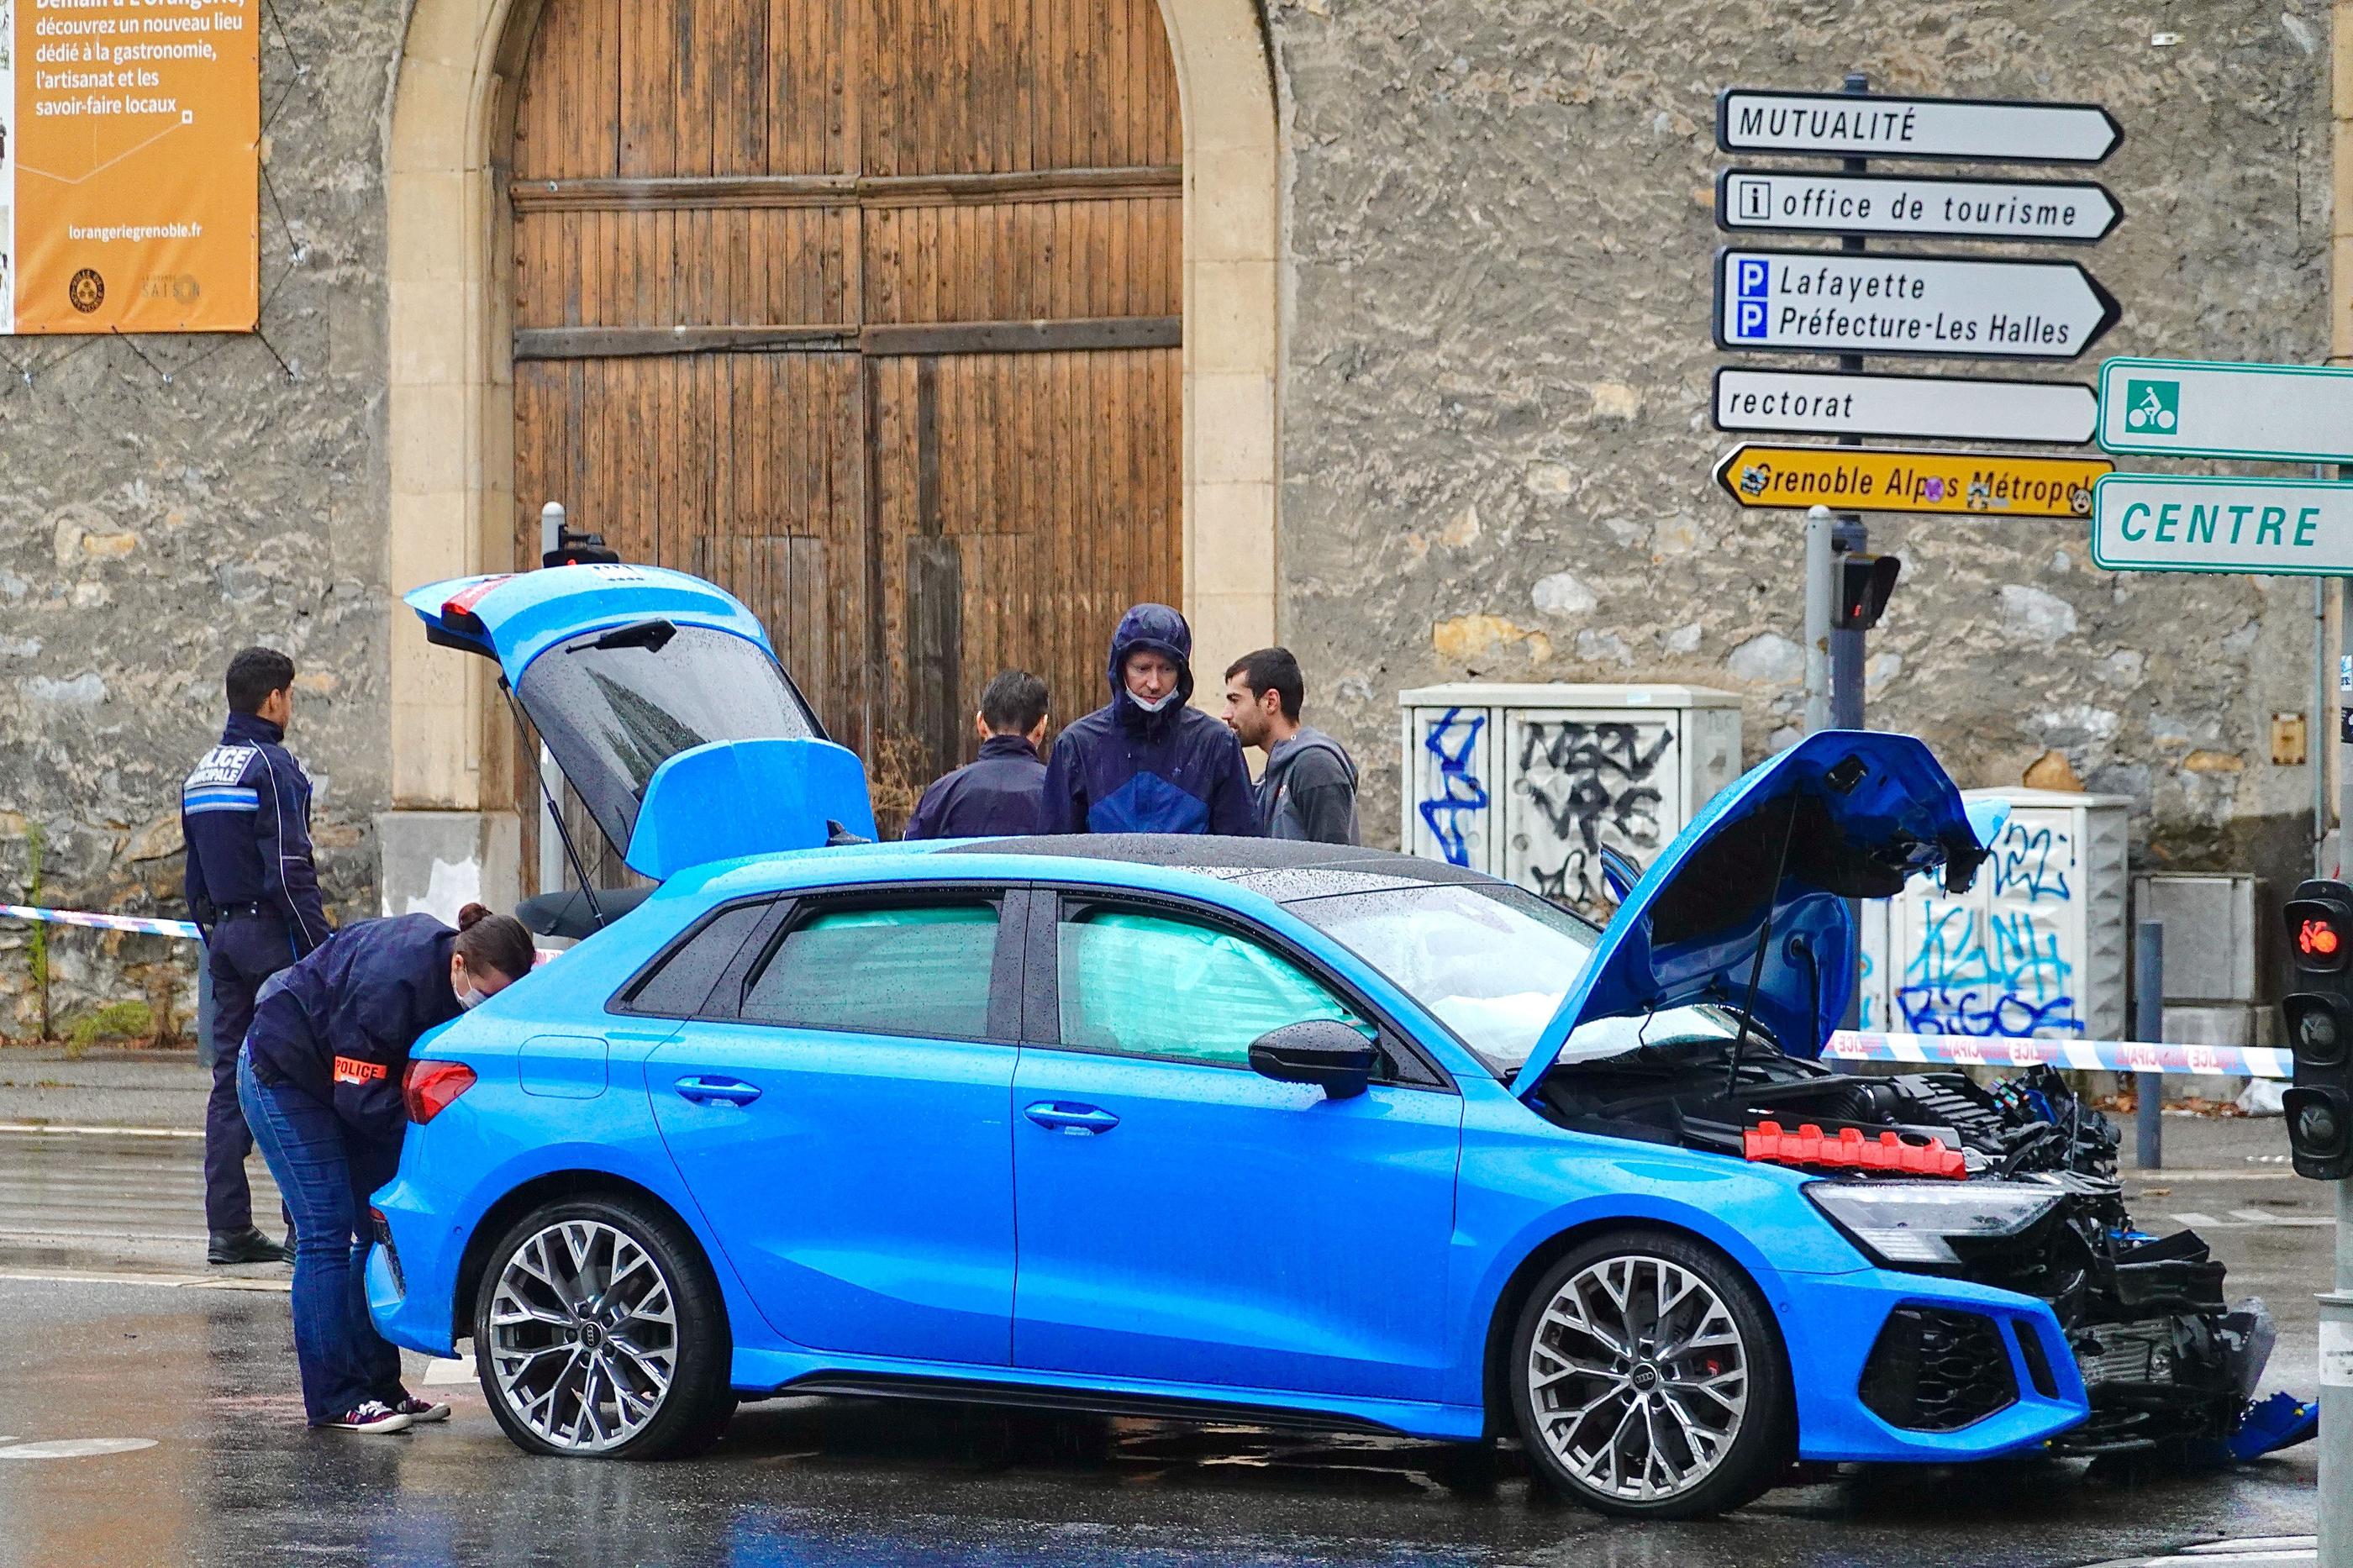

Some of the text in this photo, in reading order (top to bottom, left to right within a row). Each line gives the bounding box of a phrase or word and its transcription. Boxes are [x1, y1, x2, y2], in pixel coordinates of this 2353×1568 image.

[35, 12, 243, 35] découvrez un nouveau lieu
[35, 39, 217, 66] dédié à la gastronomie,
[36, 68, 160, 90] l'artisanat et les
[35, 95, 176, 116] savoir-faire locaux
[1740, 107, 1916, 141] MUTUALITÉ
[1783, 188, 1871, 218] office
[1892, 192, 1924, 220] de
[1945, 197, 2077, 226] tourisme
[69, 222, 203, 243] lorangeriegrenoble.fr
[1781, 266, 1924, 303] Lafayette
[1780, 308, 1977, 341] Préfecture-Les
[1989, 315, 2069, 344] Halles
[1729, 379, 1853, 418] rectorat
[1885, 466, 1959, 504] Alps
[2121, 502, 2320, 546] CENTRE
[200, 747, 250, 768] LICE
[337, 1060, 378, 1077] POLICE
